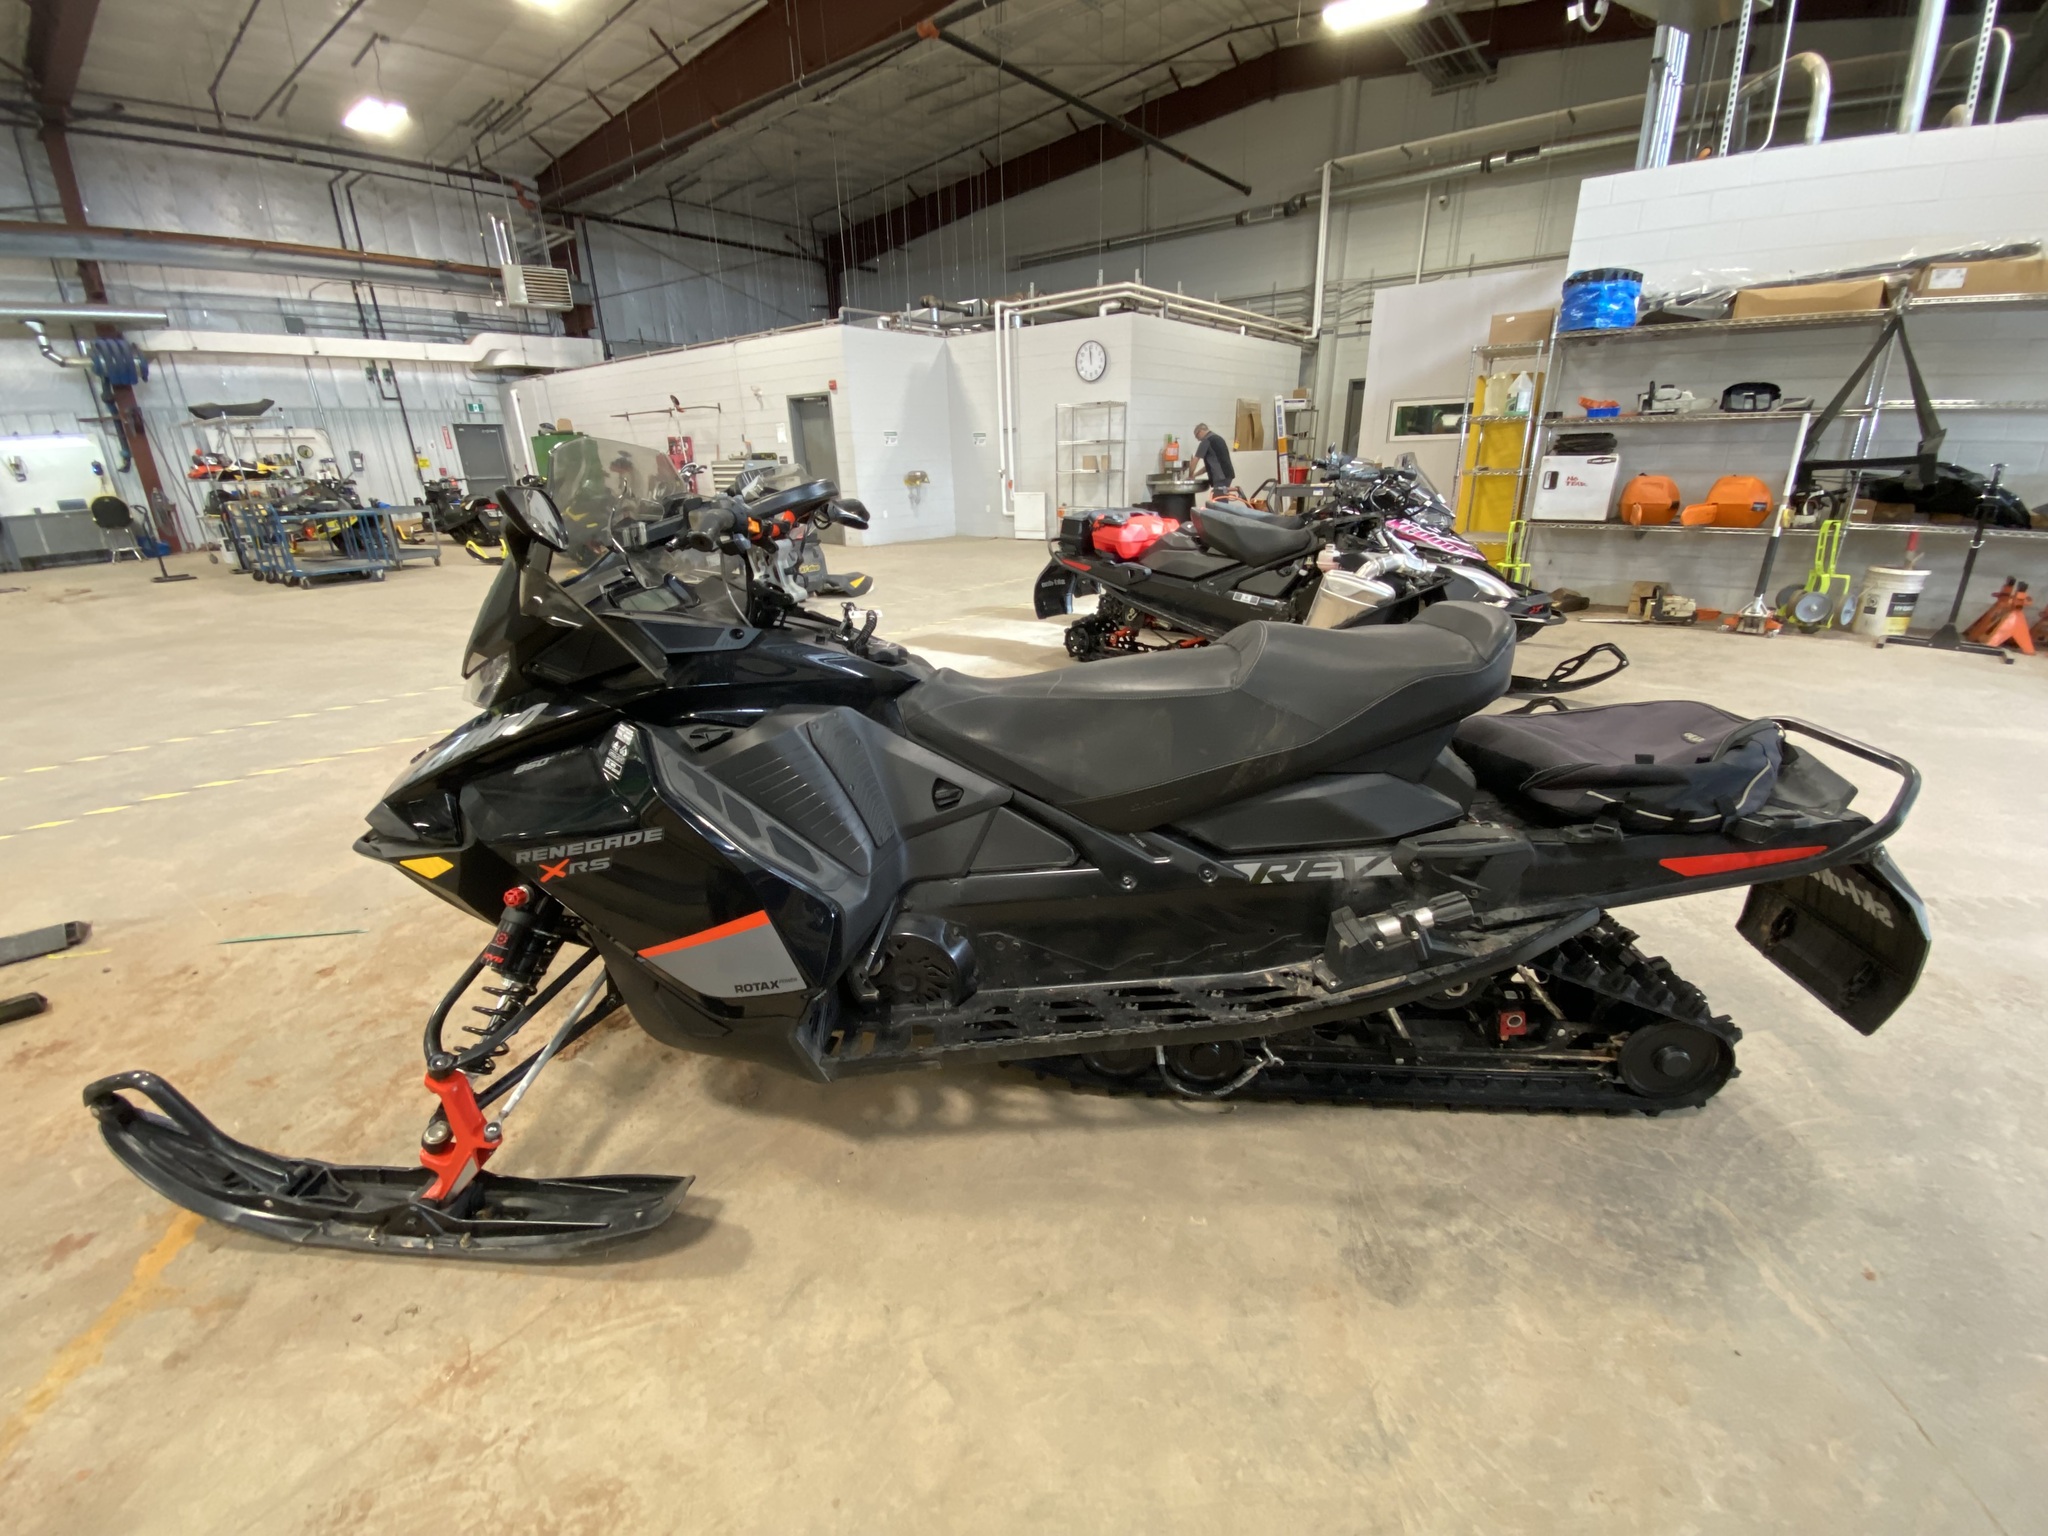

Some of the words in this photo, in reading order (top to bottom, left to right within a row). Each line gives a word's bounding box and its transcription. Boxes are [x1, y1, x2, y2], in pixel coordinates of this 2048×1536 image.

[515, 828, 663, 864] RENEGADE
[1240, 855, 1396, 884] REV
[734, 980, 779, 993] ROTAX
